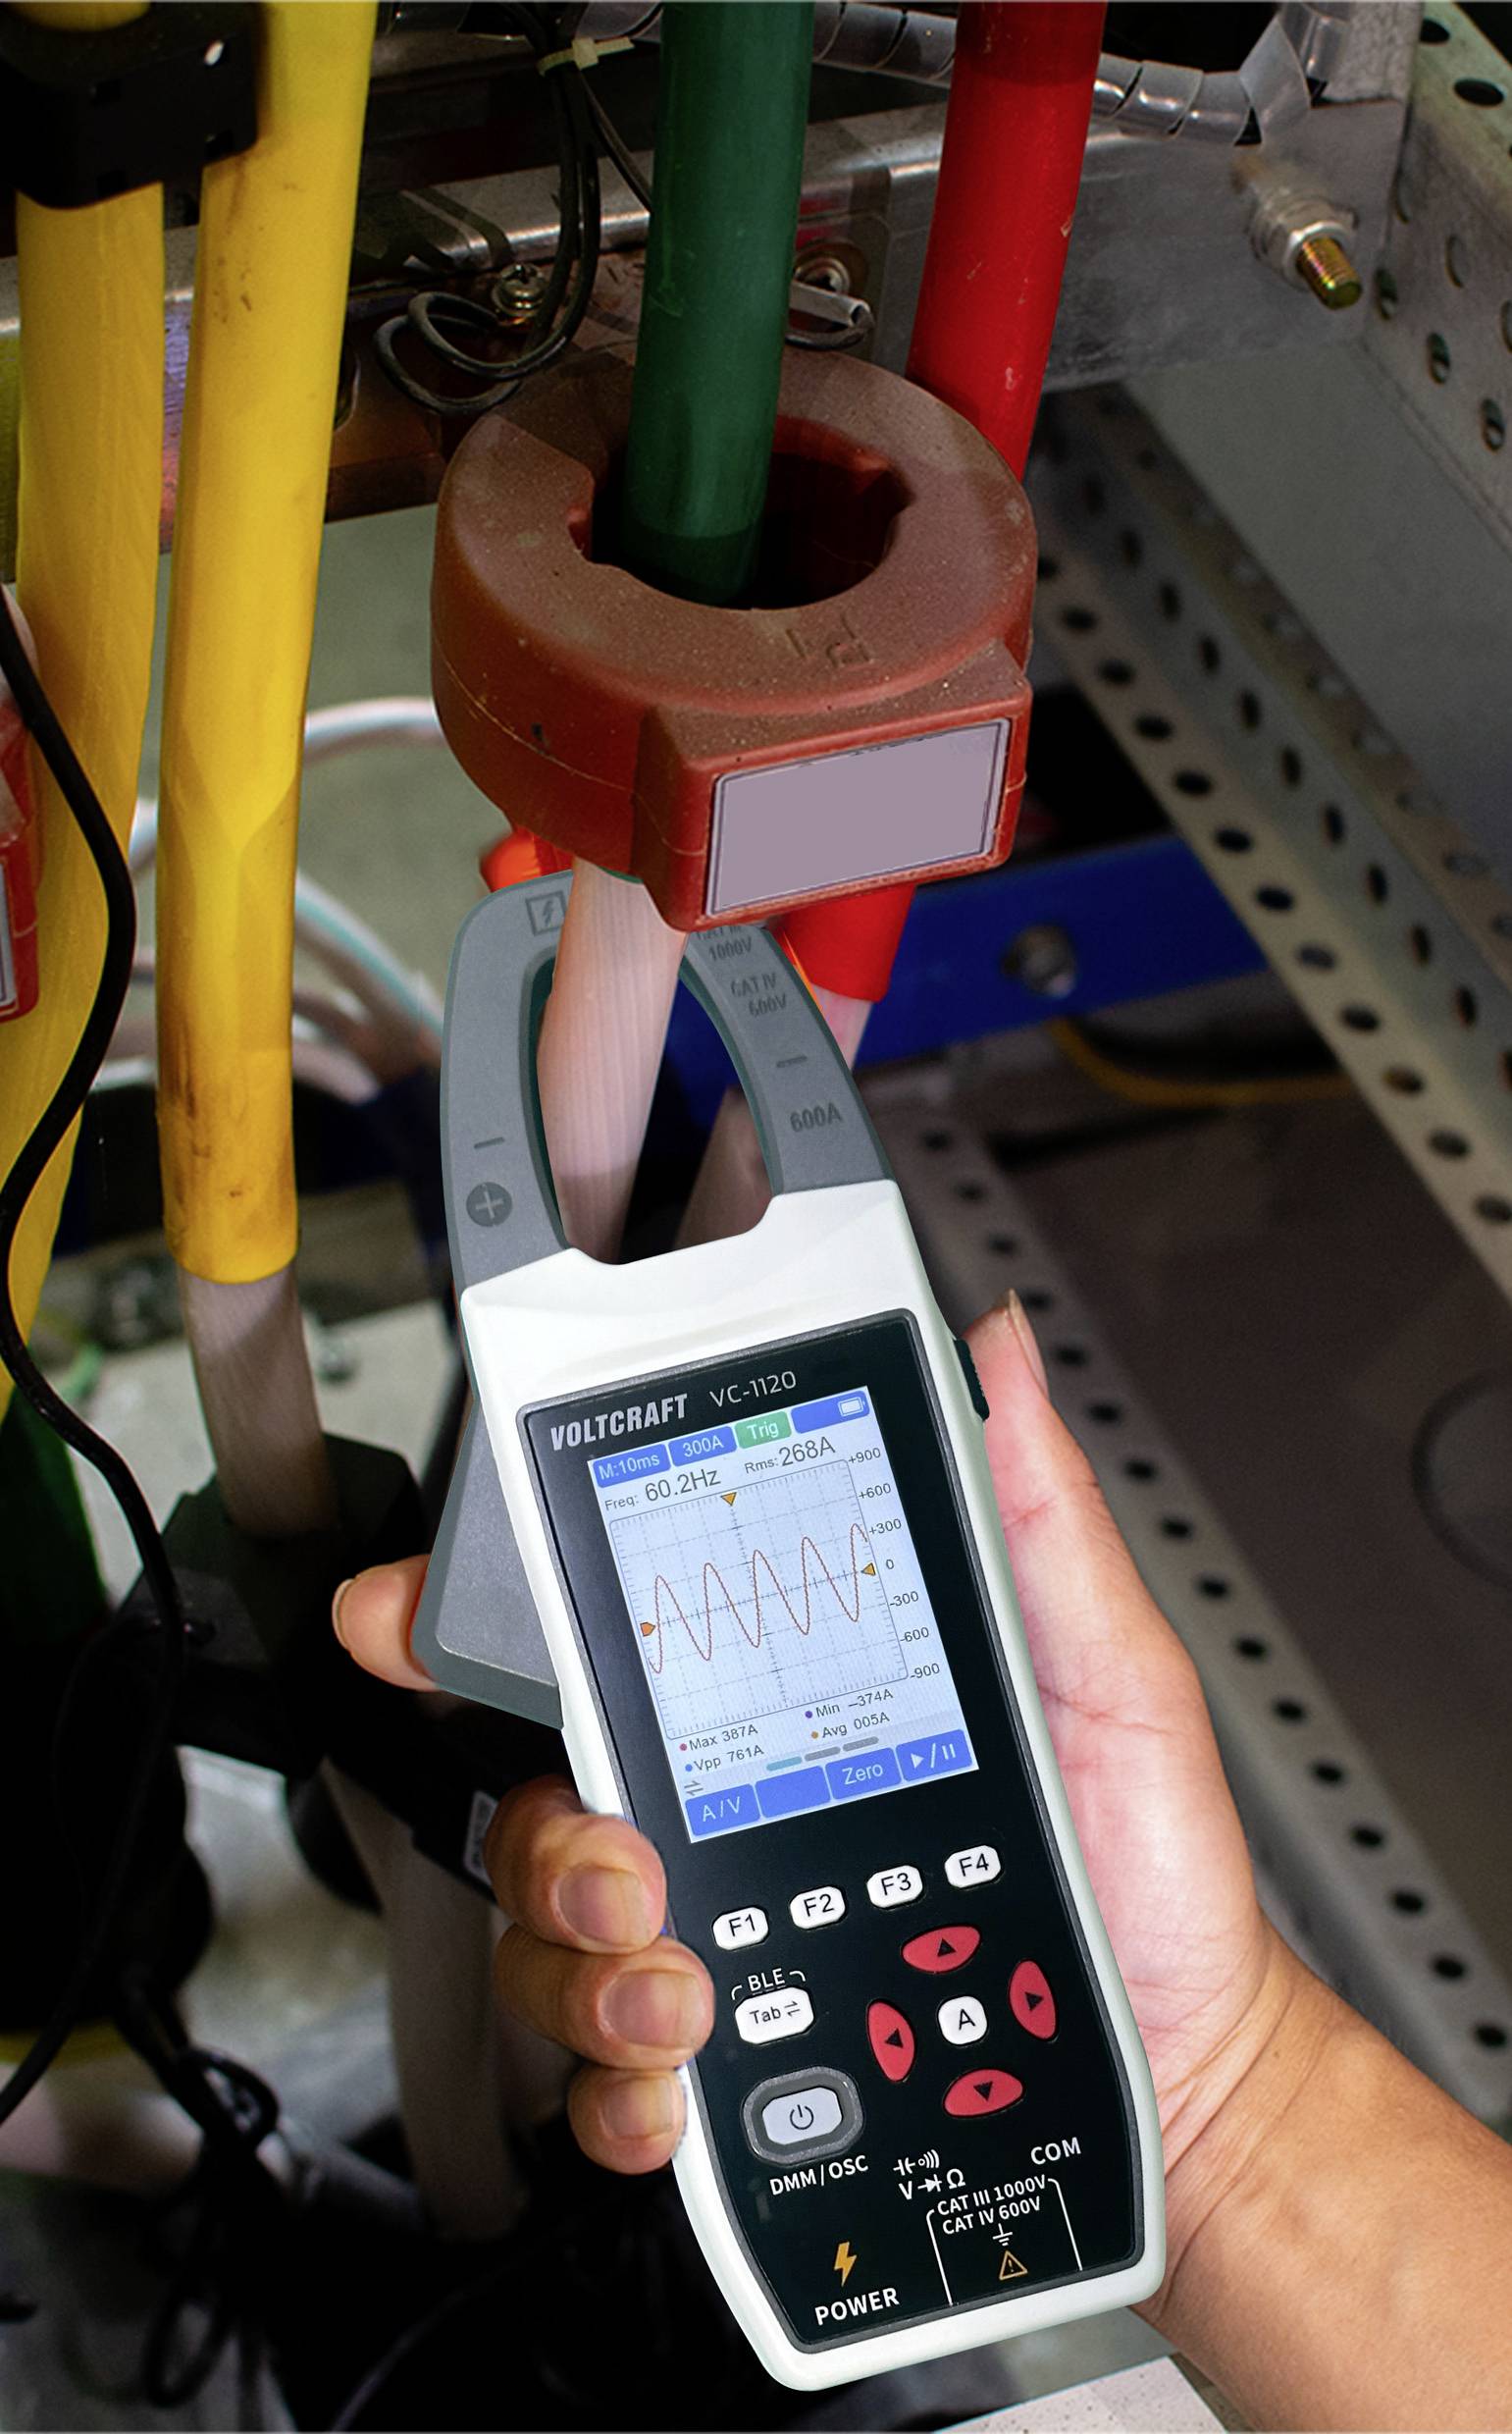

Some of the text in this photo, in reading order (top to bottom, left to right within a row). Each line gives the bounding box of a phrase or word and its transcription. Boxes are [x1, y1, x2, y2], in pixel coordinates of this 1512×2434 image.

[708, 936, 753, 961] 1000V
[731, 971, 777, 997] CAT IV
[748, 992, 787, 1018] 600V
[790, 1100, 843, 1134] 600A
[550, 1371, 797, 1452] VOLTCRAFT VC-1120
[598, 1422, 779, 1481] M:10ms 300A Trig
[848, 1447, 881, 1464] +900
[604, 1436, 836, 1511] Freq: 60.2Hz Rms: 268A
[859, 1482, 892, 1500] +600
[868, 1518, 902, 1536] +300
[885, 1559, 895, 1570] 0
[889, 1590, 919, 1608] -300
[900, 1626, 930, 1644] -600
[910, 1663, 940, 1680] -900
[815, 1702, 841, 1719] Min
[689, 1723, 758, 1752] Max 387A
[822, 1711, 890, 1739] Avg 005A
[694, 1743, 764, 1773] Vpp 761A
[842, 1763, 884, 1786] Zero
[960, 1852, 990, 1877] F4
[881, 1872, 912, 1896] F3
[804, 1892, 834, 1917] F2
[728, 1913, 756, 1937] F1
[747, 1968, 786, 1991] BLE
[749, 2004, 781, 2025] Tab
[958, 2008, 976, 2031] A
[1030, 2136, 1082, 2167] COM
[899, 2181, 912, 2200] V
[937, 2174, 1047, 2216] CAT III 1000V
[942, 2196, 1041, 2235] CAT IV 600V
[814, 2287, 901, 2326] POWER
